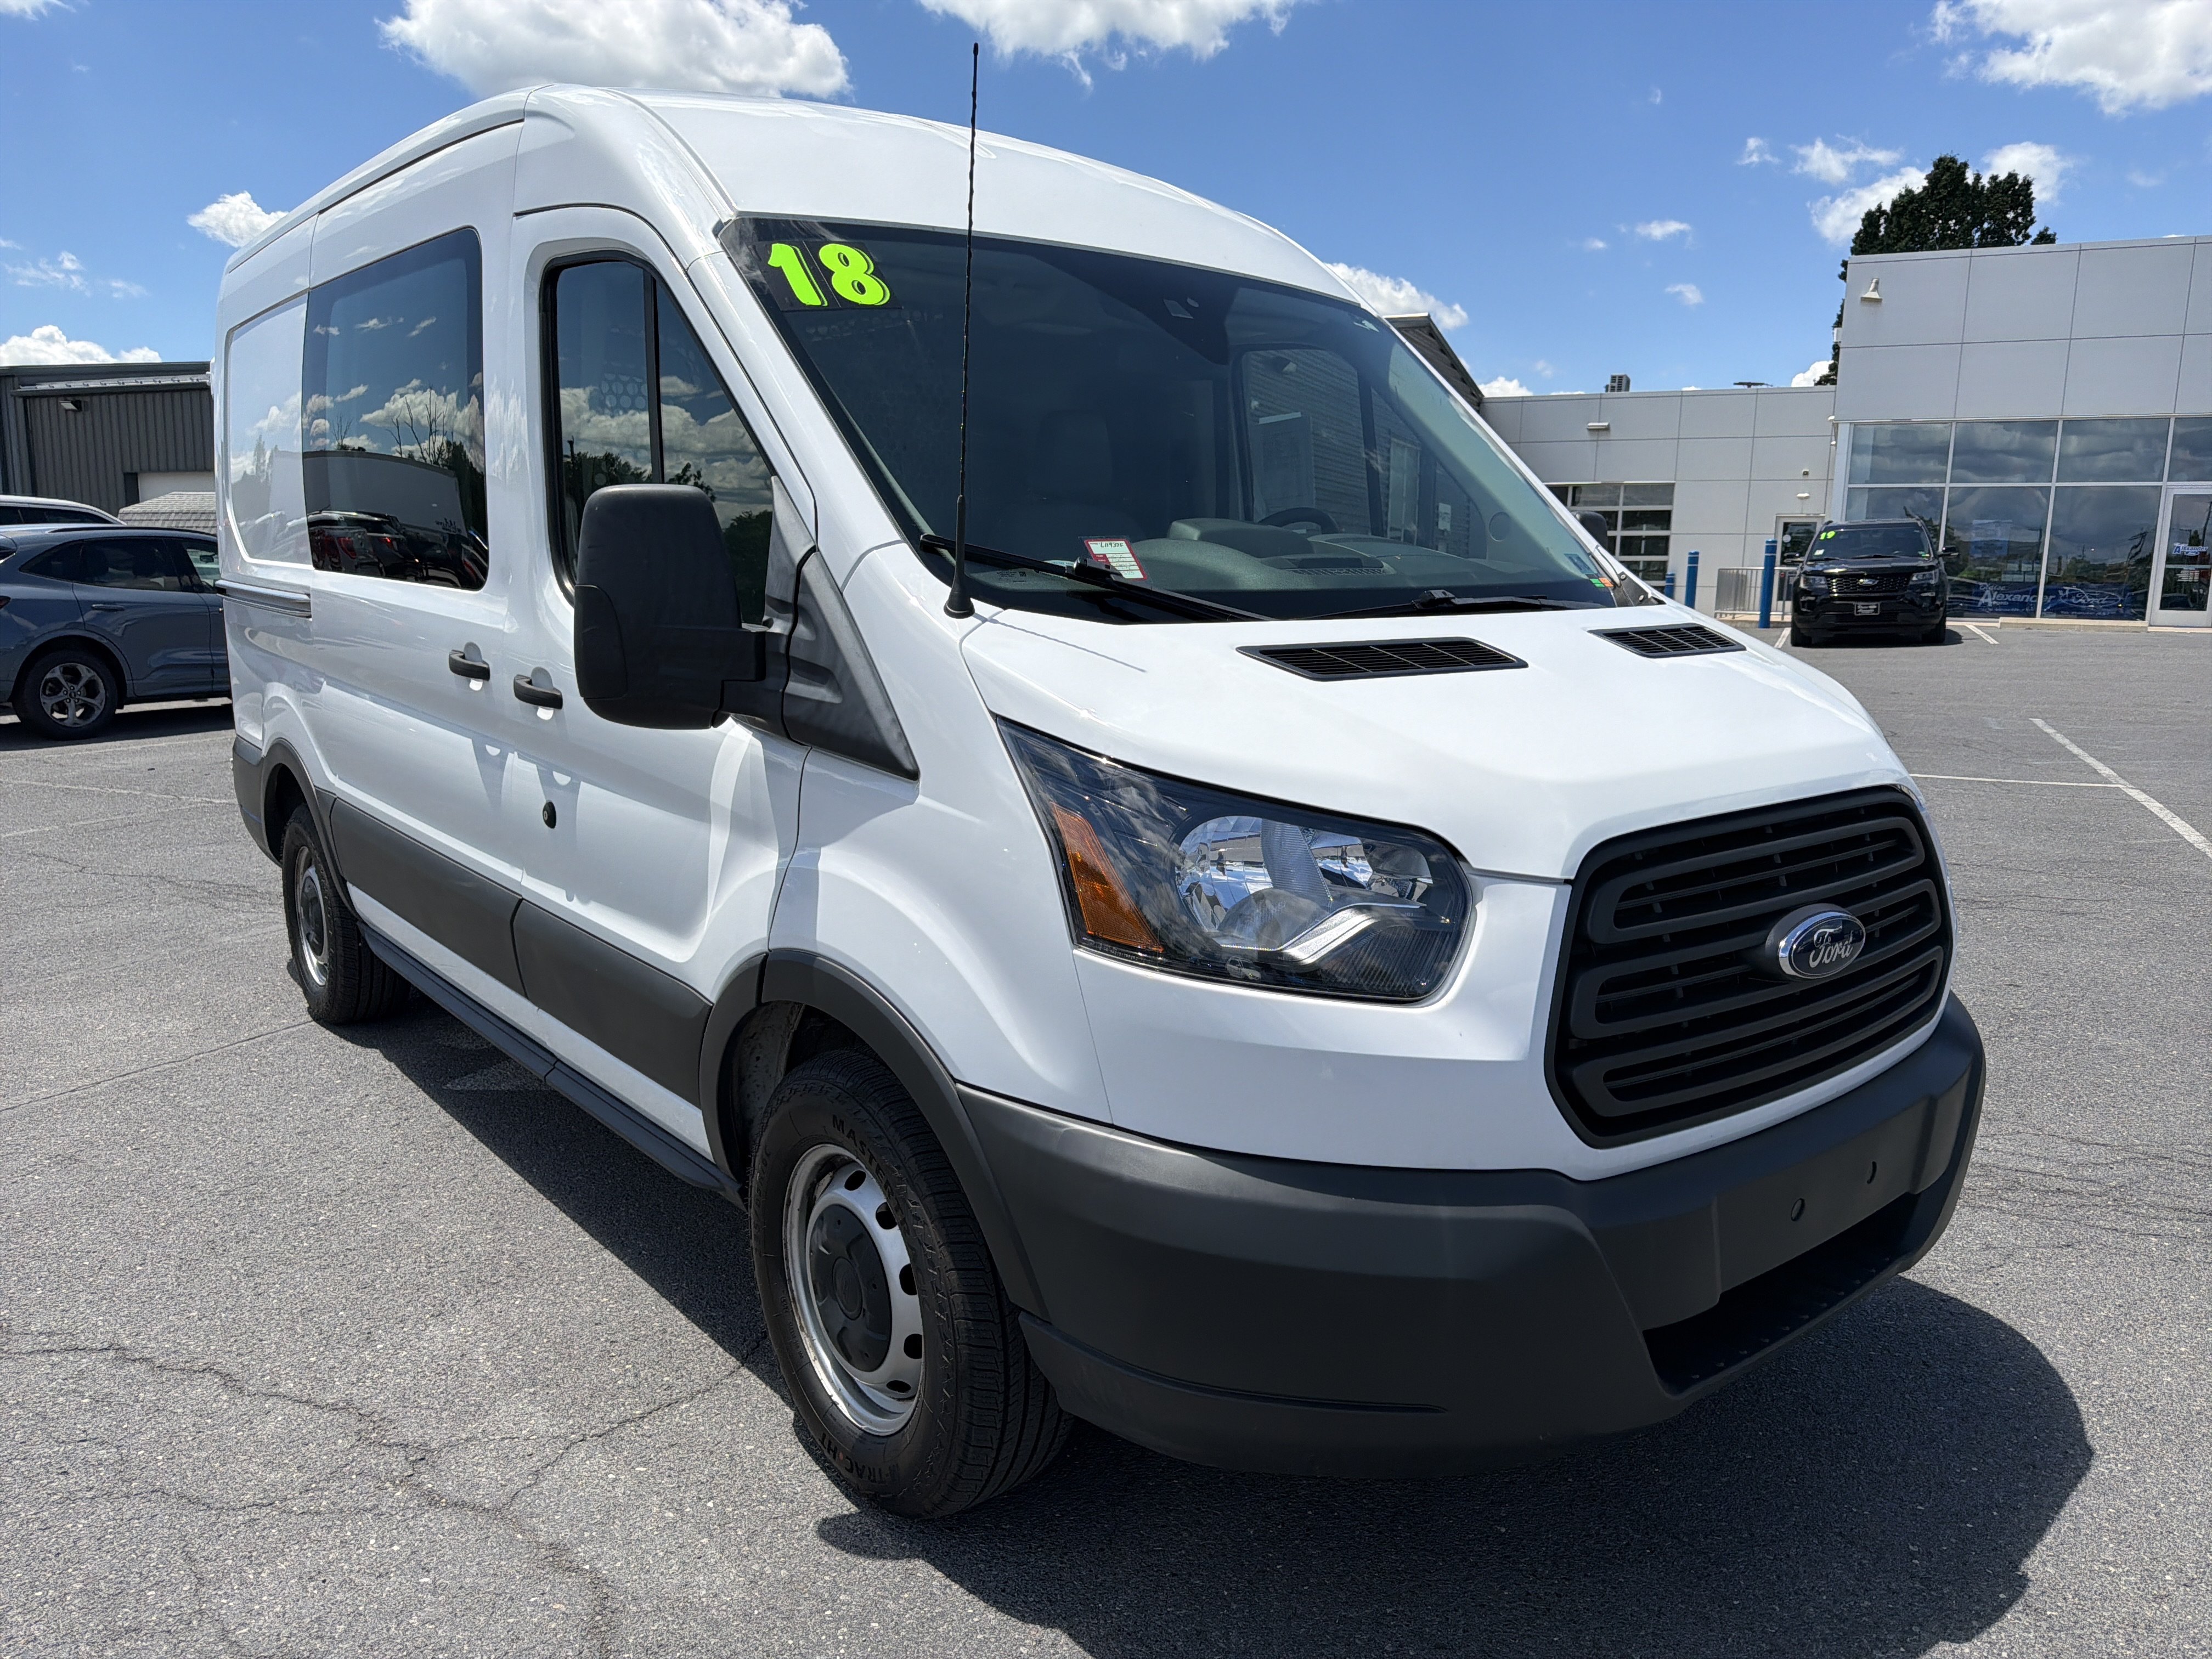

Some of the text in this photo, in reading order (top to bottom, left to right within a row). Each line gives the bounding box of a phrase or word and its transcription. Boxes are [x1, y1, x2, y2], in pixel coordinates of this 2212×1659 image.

[768, 242, 891, 307] 18
[1819, 531, 1836, 540] 19
[1808, 924, 1854, 968] Ford
[818, 1427, 837, 1459] HT
